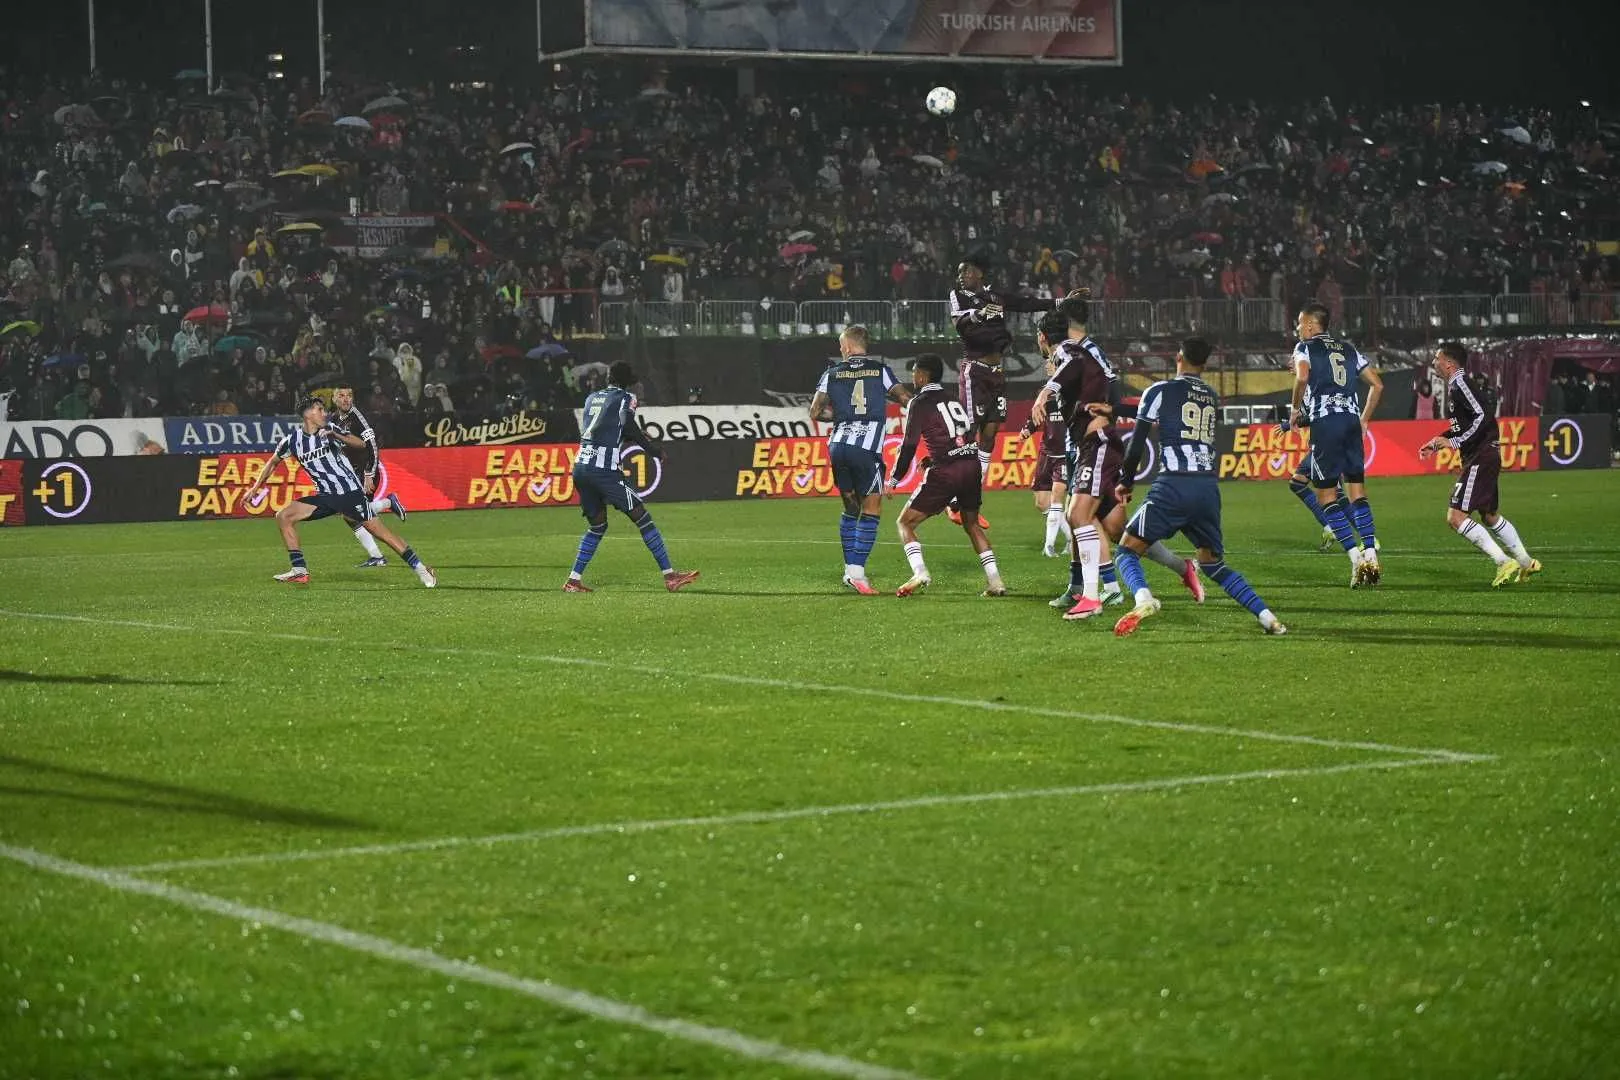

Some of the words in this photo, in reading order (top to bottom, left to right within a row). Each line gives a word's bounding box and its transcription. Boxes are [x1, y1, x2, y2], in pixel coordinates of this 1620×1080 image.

[938, 13, 1015, 31] TURKISH
[1021, 15, 1096, 32] AIRLINES
[1328, 352, 1346, 387] 6
[850, 379, 867, 415] 4
[424, 410, 546, 447] Sarajevsko
[580, 406, 602, 439] 7
[638, 411, 811, 441] beDesign
[936, 400, 970, 438] 19
[1180, 401, 1215, 444] 90
[752, 441, 827, 467] EARL
[1543, 426, 1571, 455] +1
[985, 461, 1036, 487] PAY
[1219, 451, 1308, 478] PAYOU
[32, 472, 73, 507] +1
[467, 475, 574, 504] PAYOU
[735, 467, 834, 495] PAYOU
